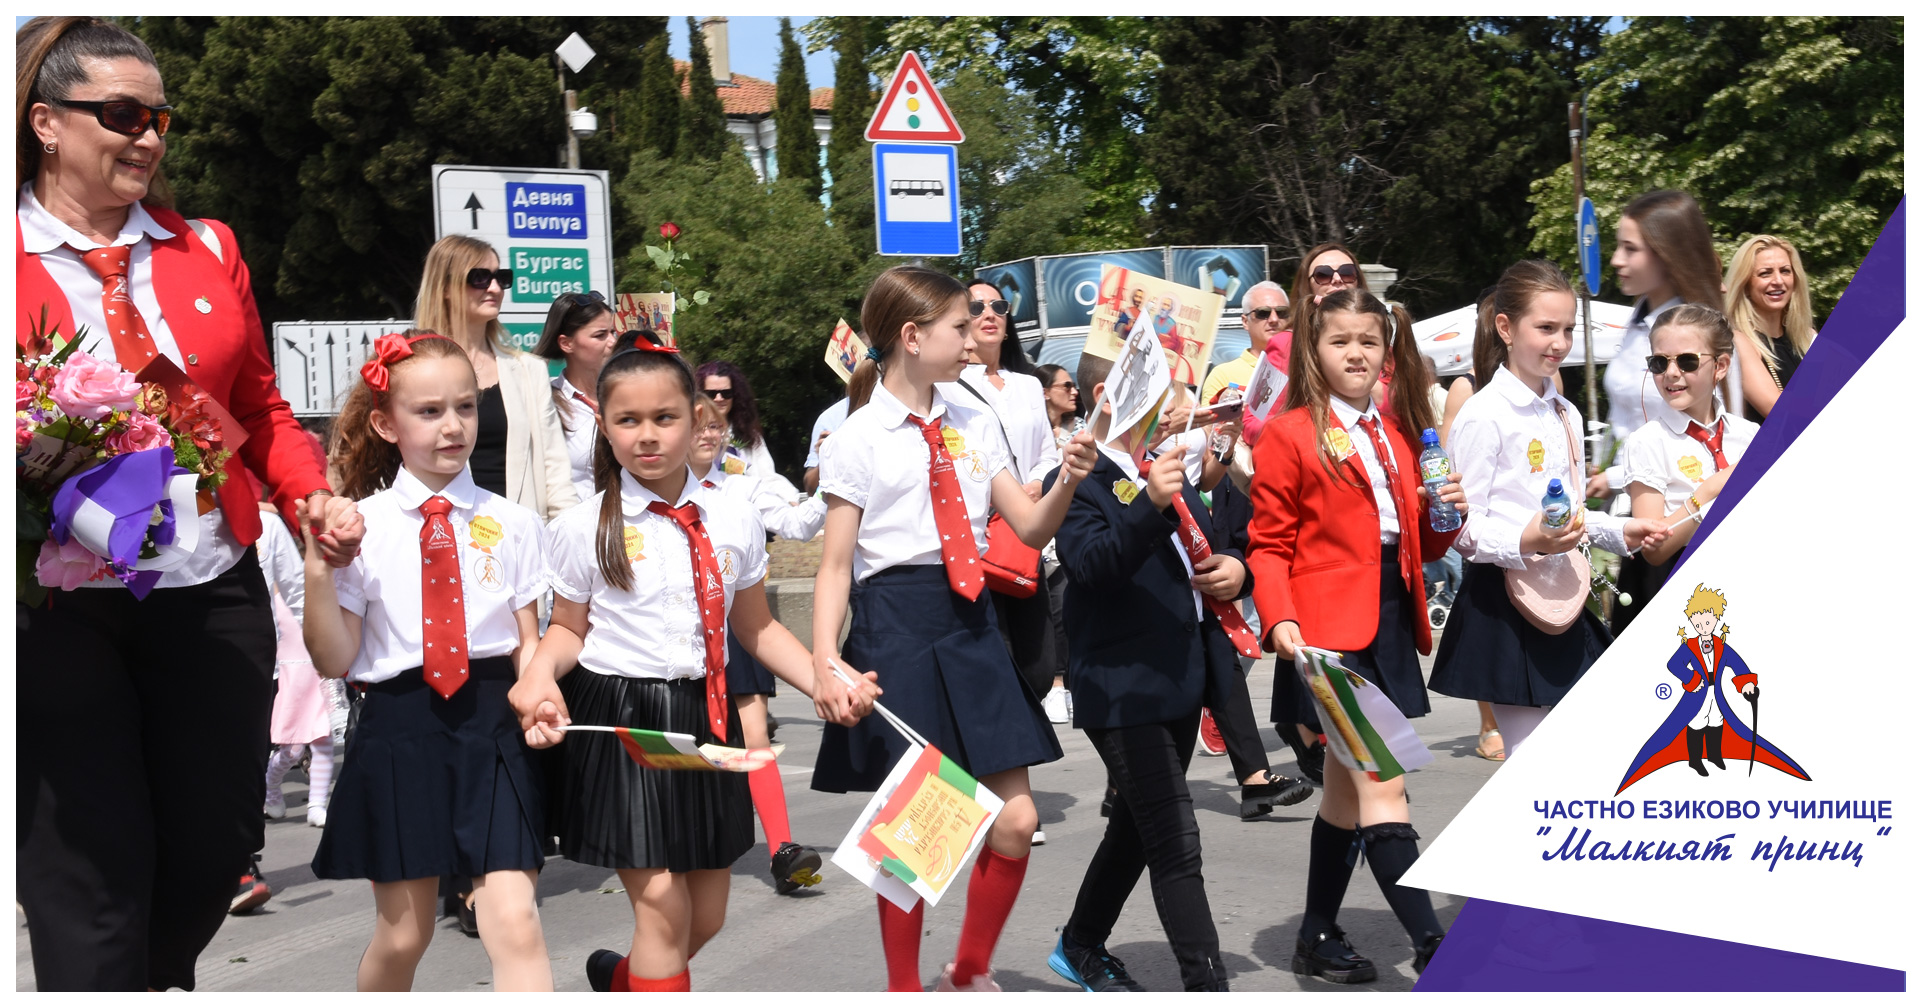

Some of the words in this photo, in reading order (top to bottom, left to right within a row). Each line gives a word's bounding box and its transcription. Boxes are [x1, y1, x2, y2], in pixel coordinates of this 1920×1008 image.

[513, 187, 573, 207] Девня
[513, 212, 582, 235] Devnya
[515, 252, 584, 273] Бургас
[517, 276, 584, 298] Burgas
[904, 830, 919, 846] 24
